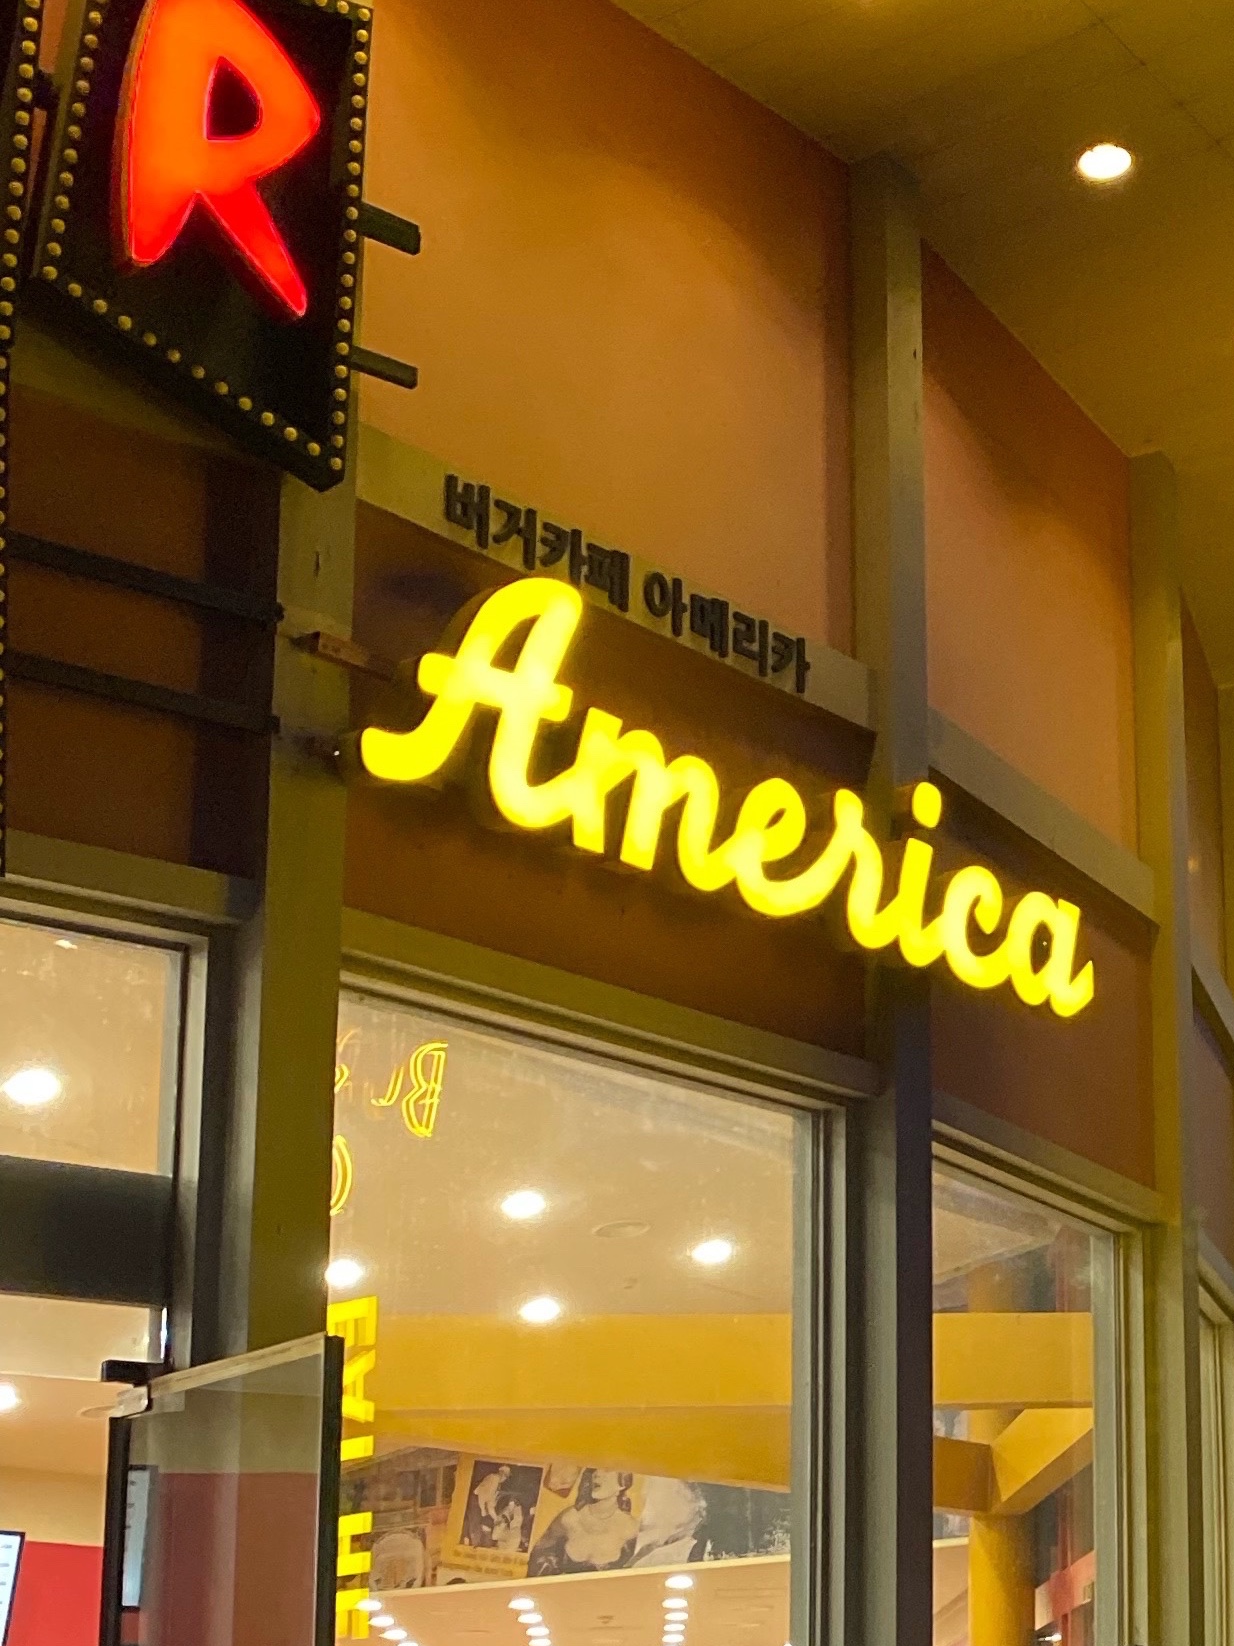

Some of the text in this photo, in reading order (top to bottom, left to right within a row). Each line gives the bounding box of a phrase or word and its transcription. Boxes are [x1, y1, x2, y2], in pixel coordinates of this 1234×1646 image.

[443, 473, 811, 694] 버거카페 아메리카
[361, 577, 1095, 1018] America
